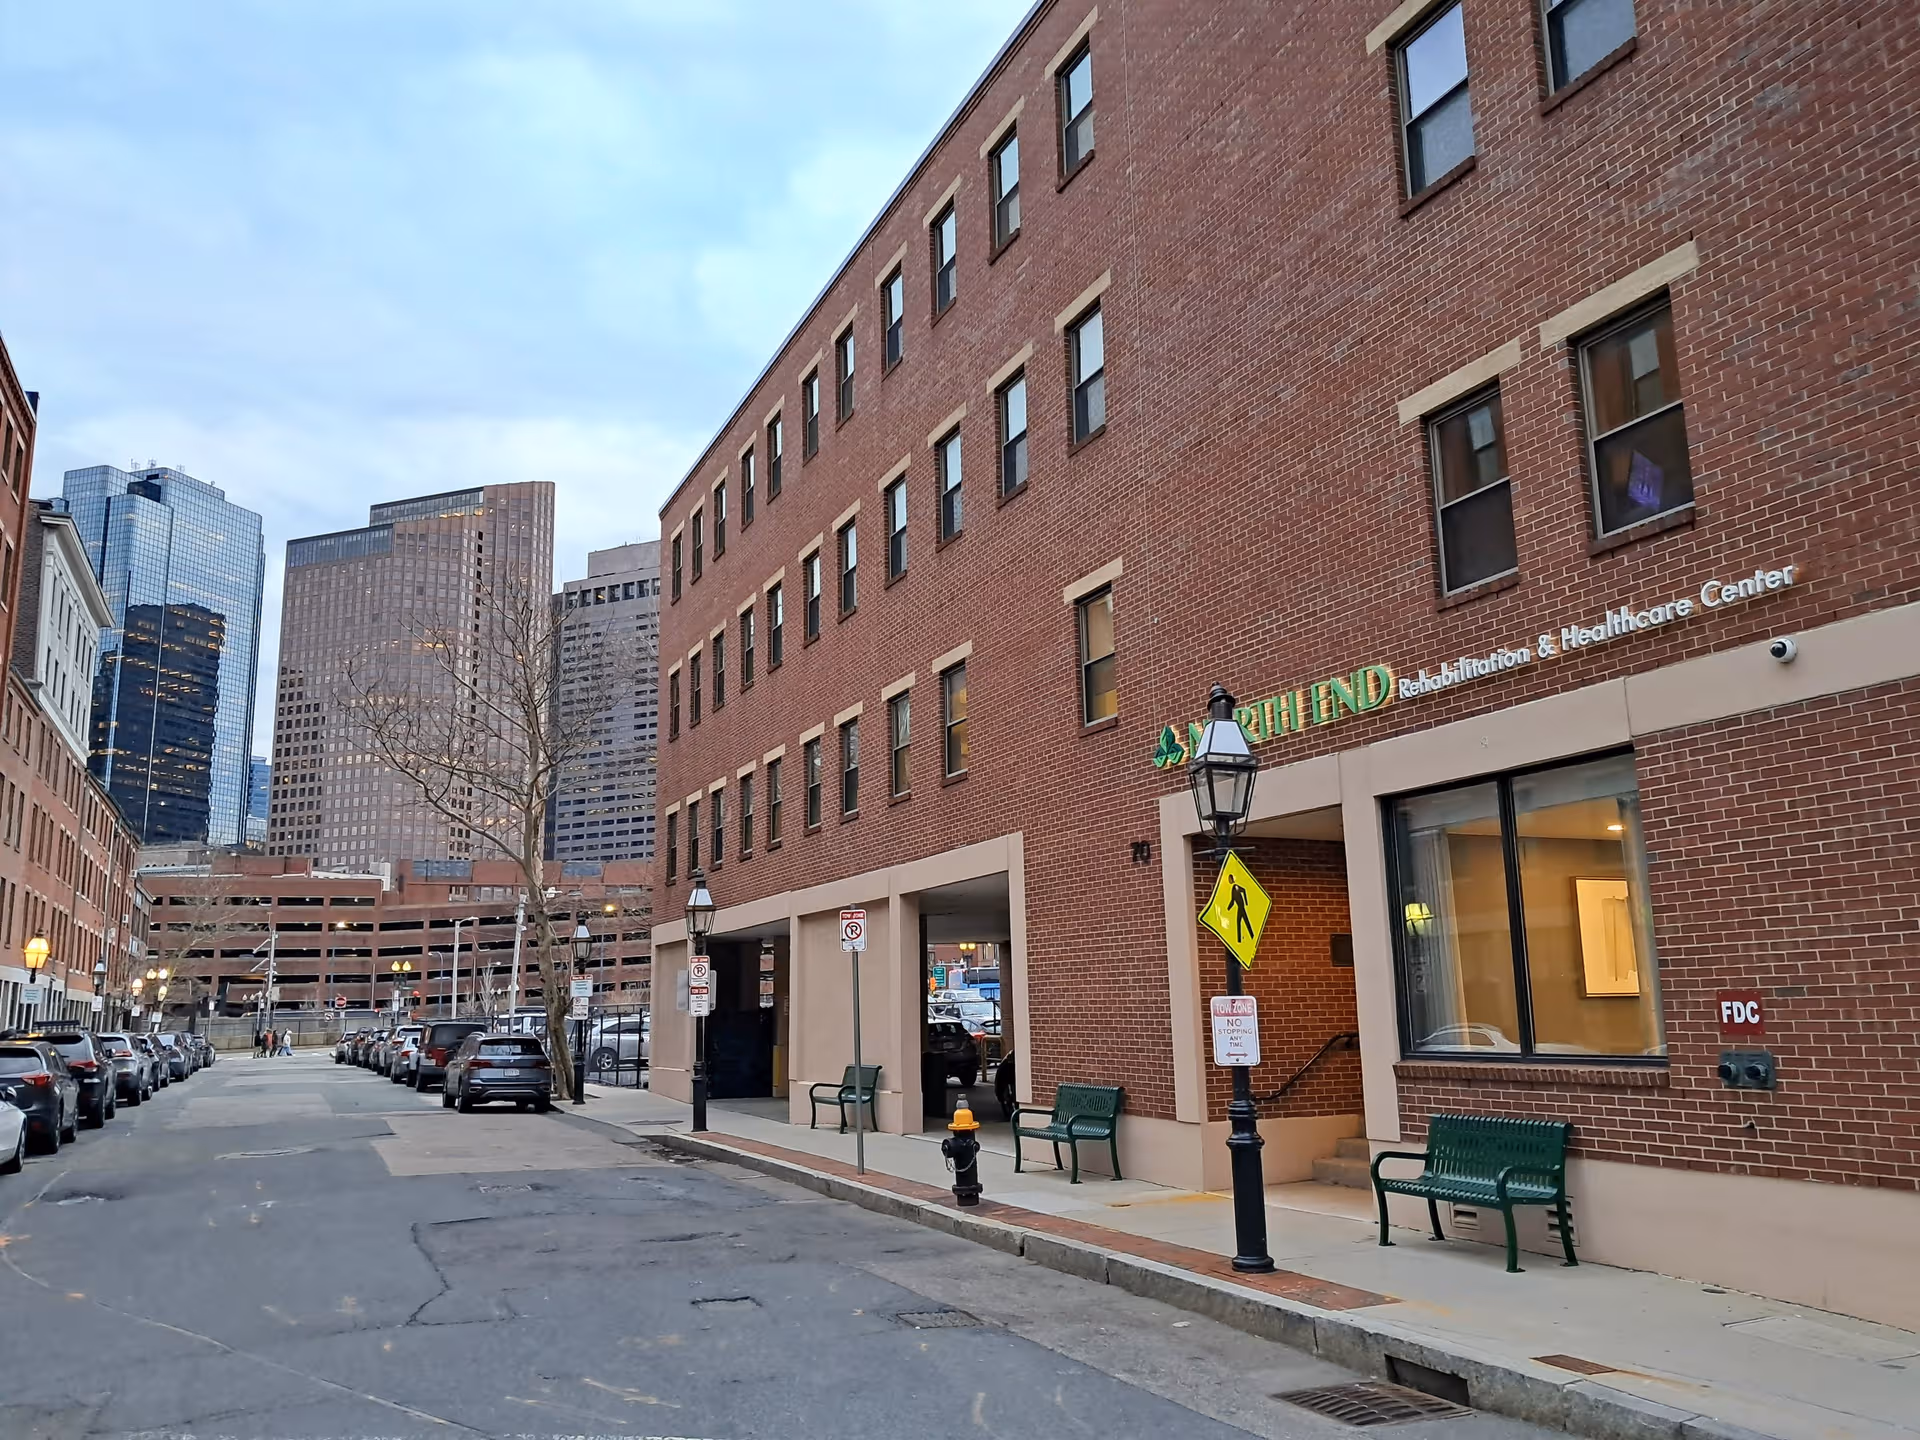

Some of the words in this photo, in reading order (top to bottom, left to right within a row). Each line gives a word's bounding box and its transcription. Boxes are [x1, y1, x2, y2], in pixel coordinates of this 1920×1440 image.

[1399, 648, 1531, 699] Rehabilitation
[1537, 634, 1558, 659] &
[1561, 597, 1694, 651] Healthcare
[1701, 565, 1795, 608] Center
[1188, 691, 1299, 759] NRTH
[1310, 665, 1391, 725] END
[1215, 1003, 1231, 1014] TOW
[1233, 1003, 1253, 1014] ZONE
[1721, 1001, 1760, 1024] FDC
[1226, 1018, 1242, 1027] NO
